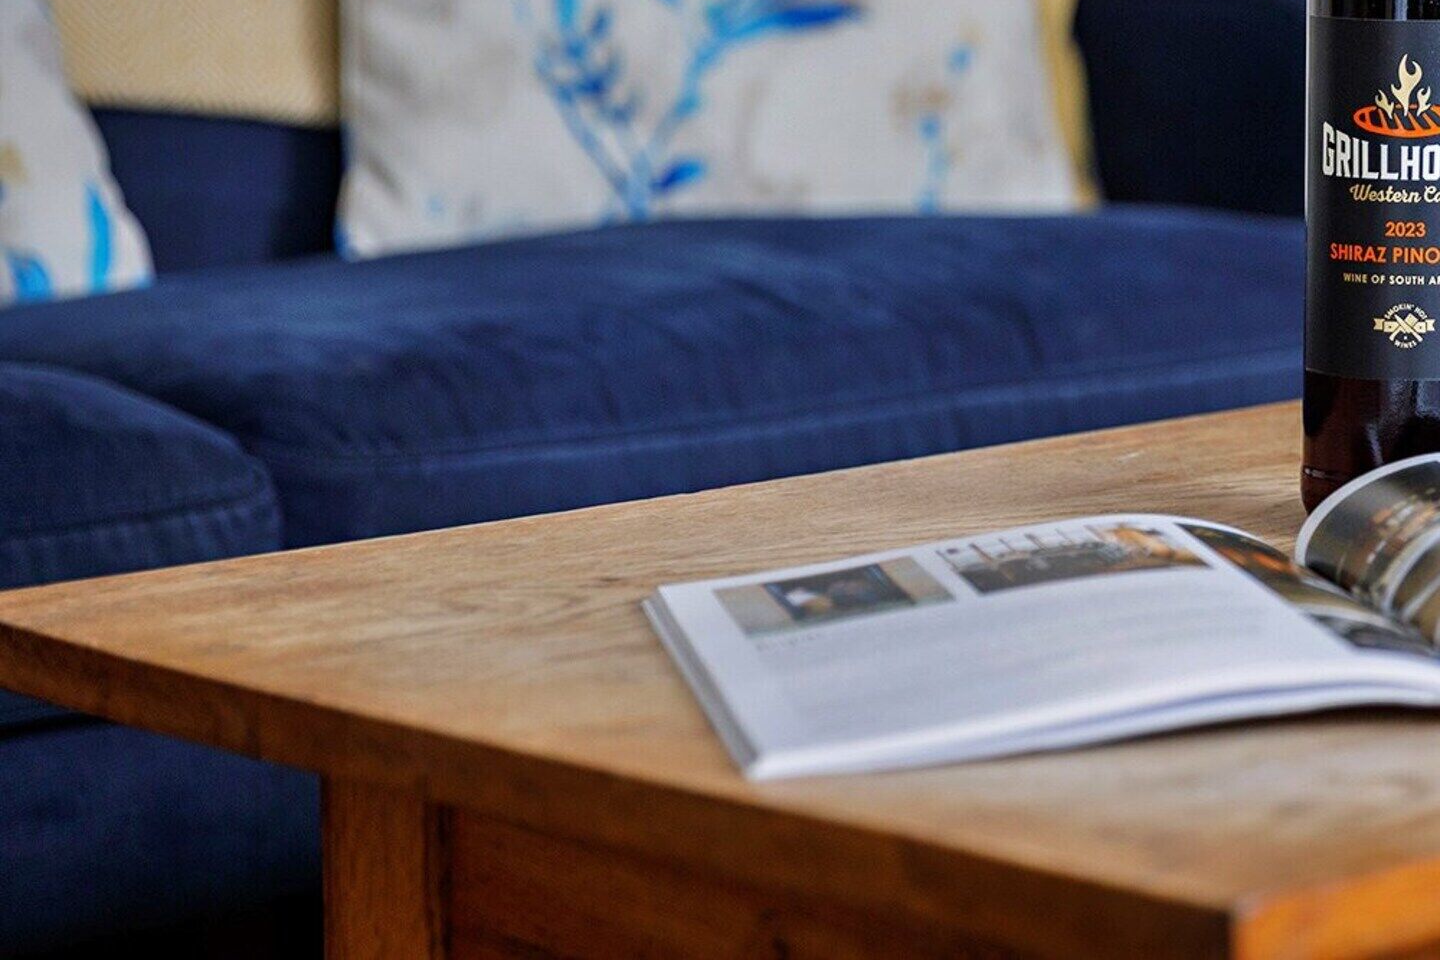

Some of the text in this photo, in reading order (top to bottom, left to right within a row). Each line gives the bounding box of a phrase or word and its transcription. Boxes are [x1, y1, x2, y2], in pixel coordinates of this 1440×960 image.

[1349, 184, 1422, 203] Western
[1384, 221, 1427, 238] 2023
[1330, 242, 1387, 264] SHIRAZ
[1343, 272, 1368, 284] WINE
[1371, 274, 1386, 284] OF
[1389, 275, 1425, 285] SOUTH
